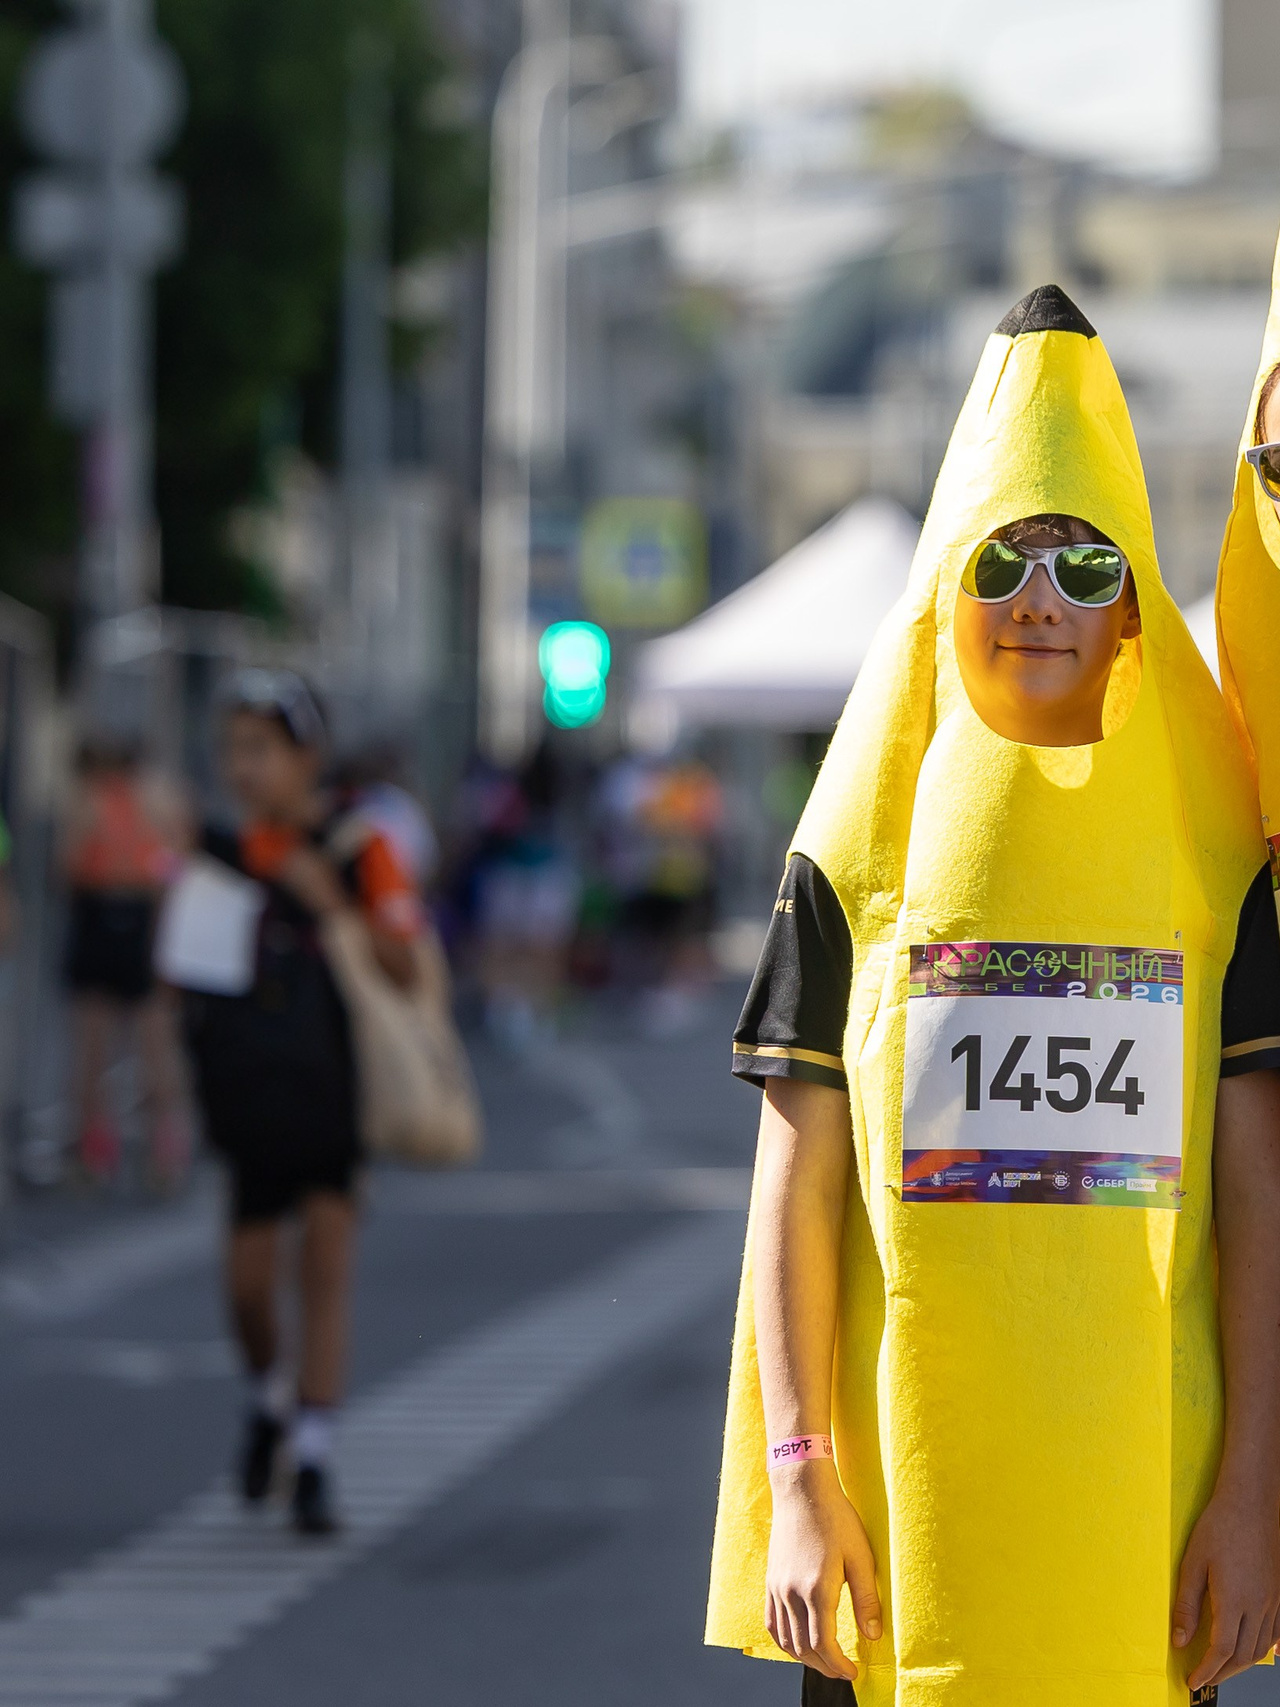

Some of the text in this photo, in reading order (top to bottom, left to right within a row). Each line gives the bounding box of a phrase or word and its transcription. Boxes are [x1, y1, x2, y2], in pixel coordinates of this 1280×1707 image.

[932, 948, 1163, 983] КРАСОЧНЫЙ
[932, 981, 1179, 1005] ЗАБЕГ 2026
[950, 1034, 1145, 1116] 1454
[1096, 1178, 1125, 1188] СБЕР
[773, 1439, 812, 1459] 1454
